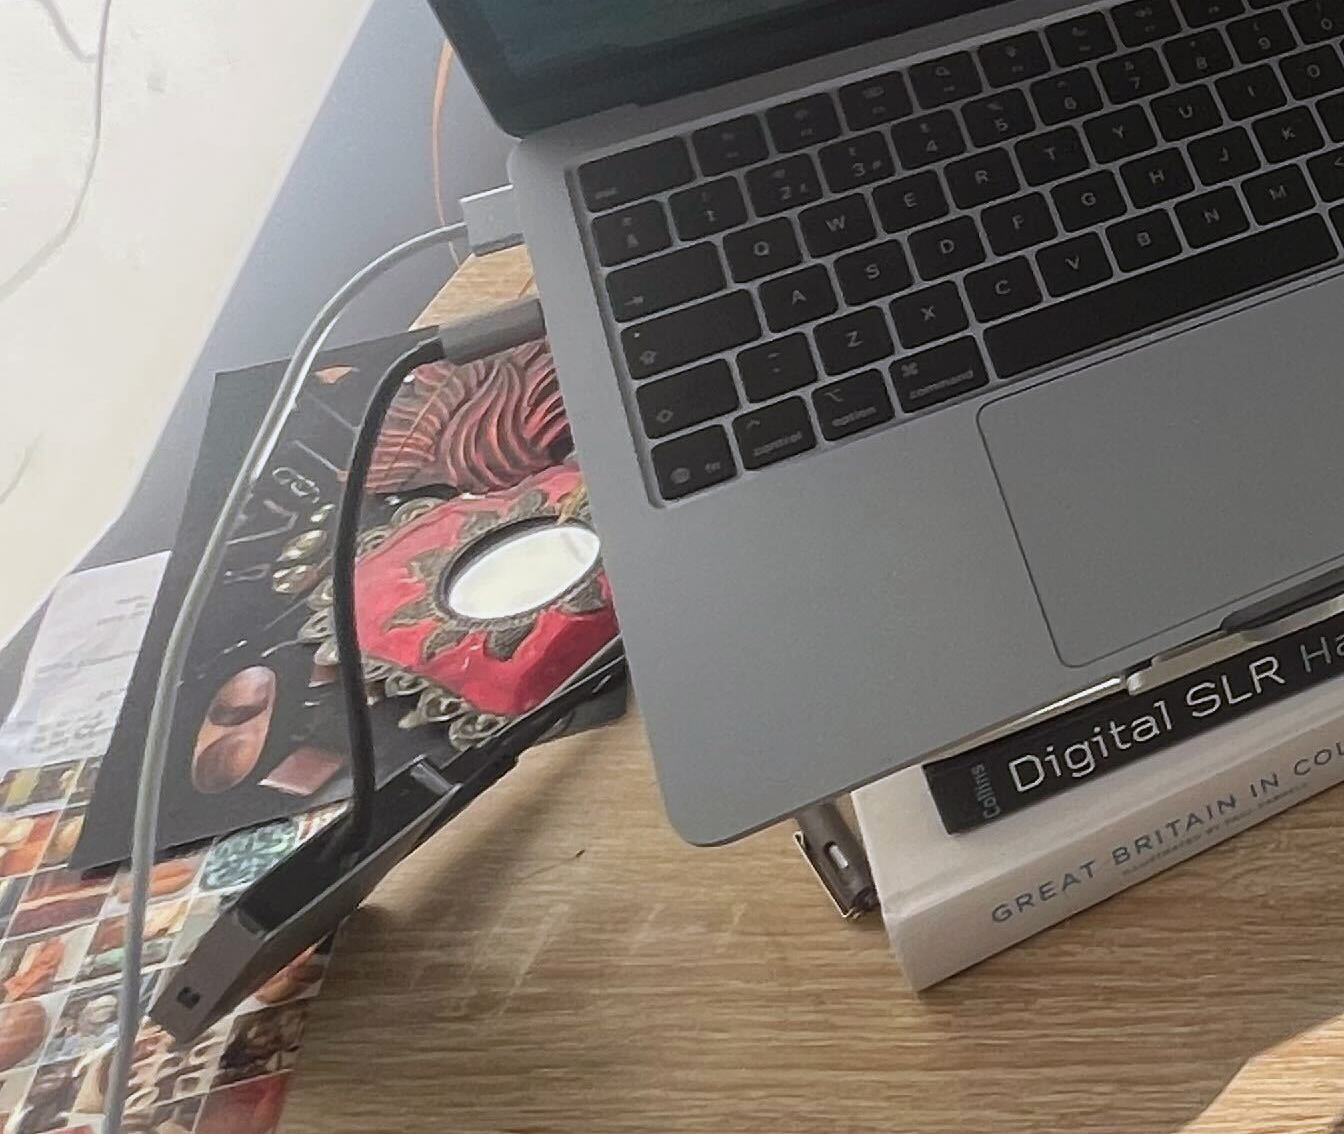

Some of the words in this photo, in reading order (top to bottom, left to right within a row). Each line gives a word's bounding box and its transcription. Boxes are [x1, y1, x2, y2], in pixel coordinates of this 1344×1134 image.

[1321, 18, 1332, 30] 0
[1258, 37, 1271, 49] 9
[1307, 65, 1320, 77] O
[1179, 105, 1192, 118] U
[1112, 126, 1123, 138] Y
[1282, 127, 1295, 139] K
[926, 140, 938, 151] 4
[1044, 147, 1055, 160] T
[1220, 148, 1228, 161] J
[852, 163, 866, 177] 3
[975, 170, 988, 183] R
[1149, 170, 1164, 184] H
[780, 186, 791, 200] 2
[1081, 193, 1096, 206] G
[1269, 185, 1286, 200] M
[904, 193, 917, 207] E
[1013, 215, 1023, 229] F
[1205, 209, 1219, 223] N
[826, 216, 845, 231] W
[754, 242, 769, 256] Q
[940, 239, 954, 253] D
[1065, 257, 1079, 269] V
[866, 264, 879, 279] S
[995, 280, 1010, 294] C
[792, 290, 806, 304] A
[921, 306, 935, 320] X
[847, 331, 862, 347] Z
[909, 370, 974, 400] command
[1007, 700, 1174, 796] Digital
[1185, 655, 1286, 719] SLR
[970, 763, 1002, 820] Collins
[992, 860, 1097, 925] GREAT
[1112, 793, 1238, 866] BRITAIN
[1249, 772, 1279, 799] IN
